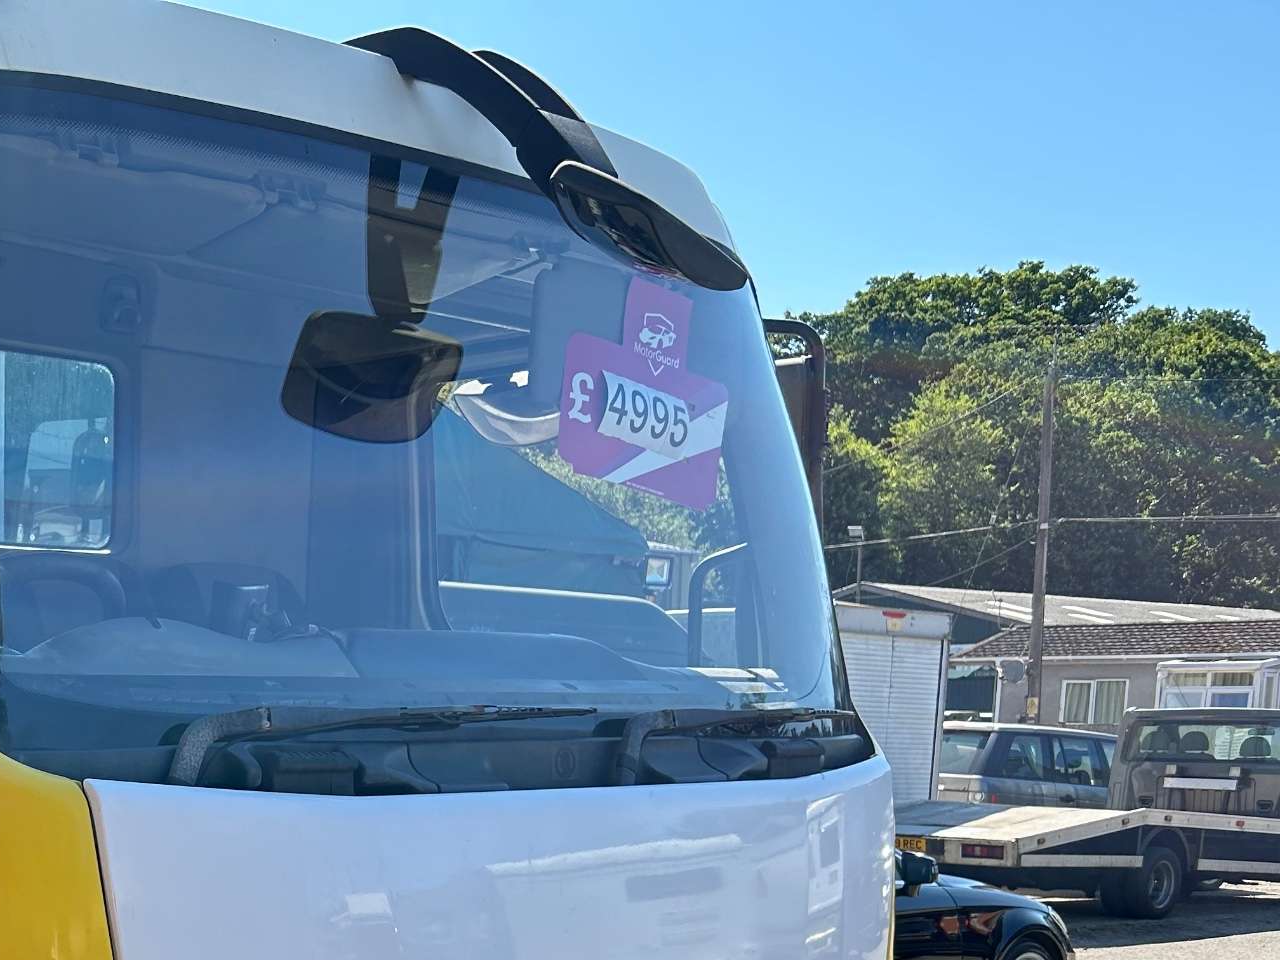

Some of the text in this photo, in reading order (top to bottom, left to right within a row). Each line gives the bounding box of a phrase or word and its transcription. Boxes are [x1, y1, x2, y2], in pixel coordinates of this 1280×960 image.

[633, 341, 680, 369] MotorGuard
[567, 371, 688, 448] £ 4995
[902, 839, 922, 849] REC
